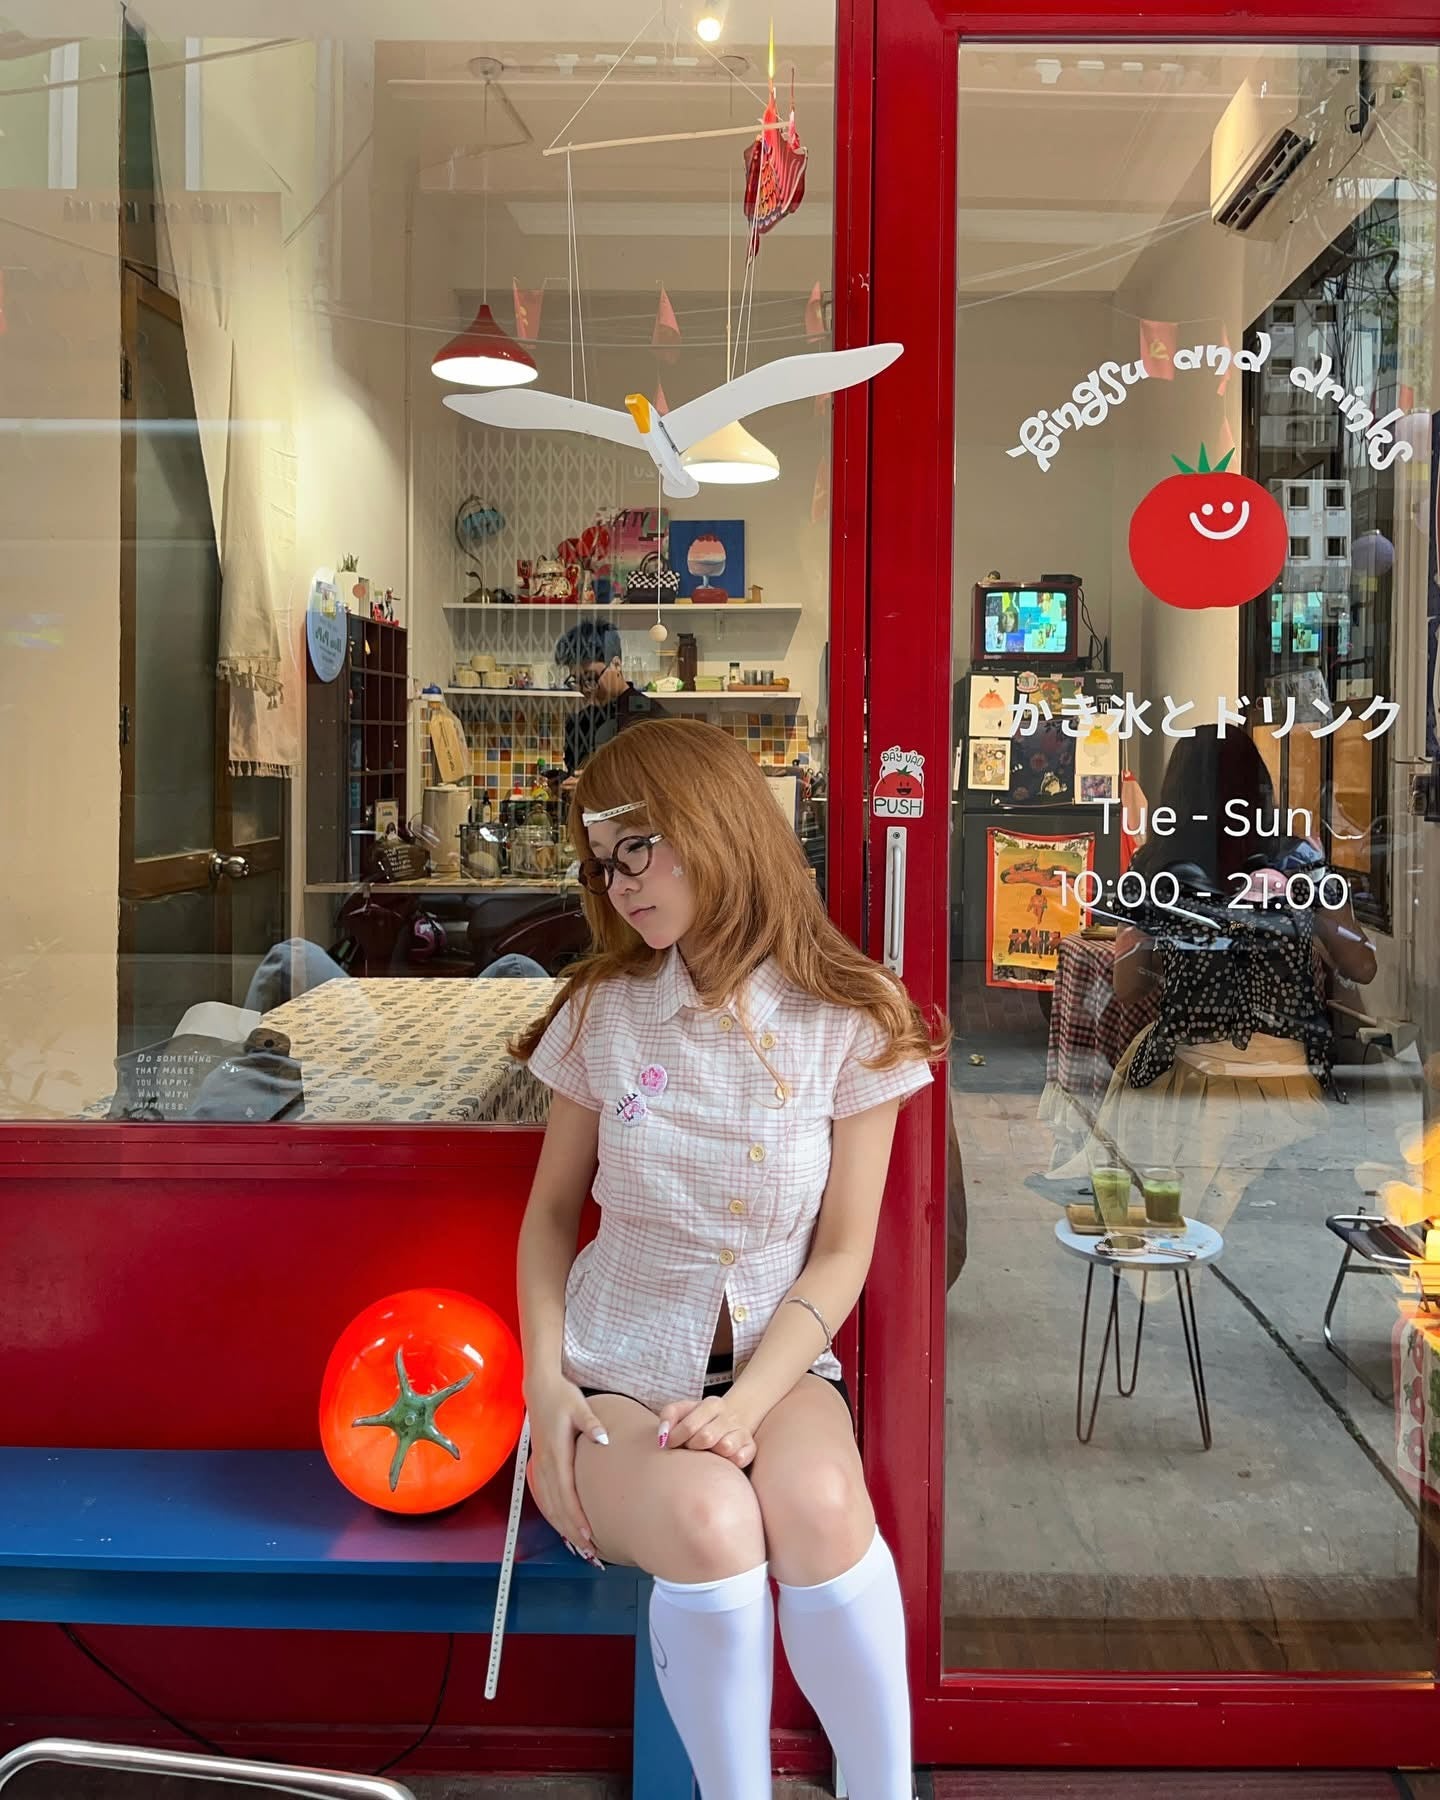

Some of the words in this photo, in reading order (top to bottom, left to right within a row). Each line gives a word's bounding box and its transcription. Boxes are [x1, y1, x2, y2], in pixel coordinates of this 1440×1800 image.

[1173, 331, 1272, 375] and
[1289, 353, 1414, 472] drinks
[1008, 692, 1402, 741] かき氷とドリンク
[874, 798, 922, 816] PUSH
[1093, 798, 1178, 836] Tue
[1223, 799, 1312, 837] Sun
[1053, 871, 1180, 908] 10:00
[1227, 873, 1348, 910] 21:00
